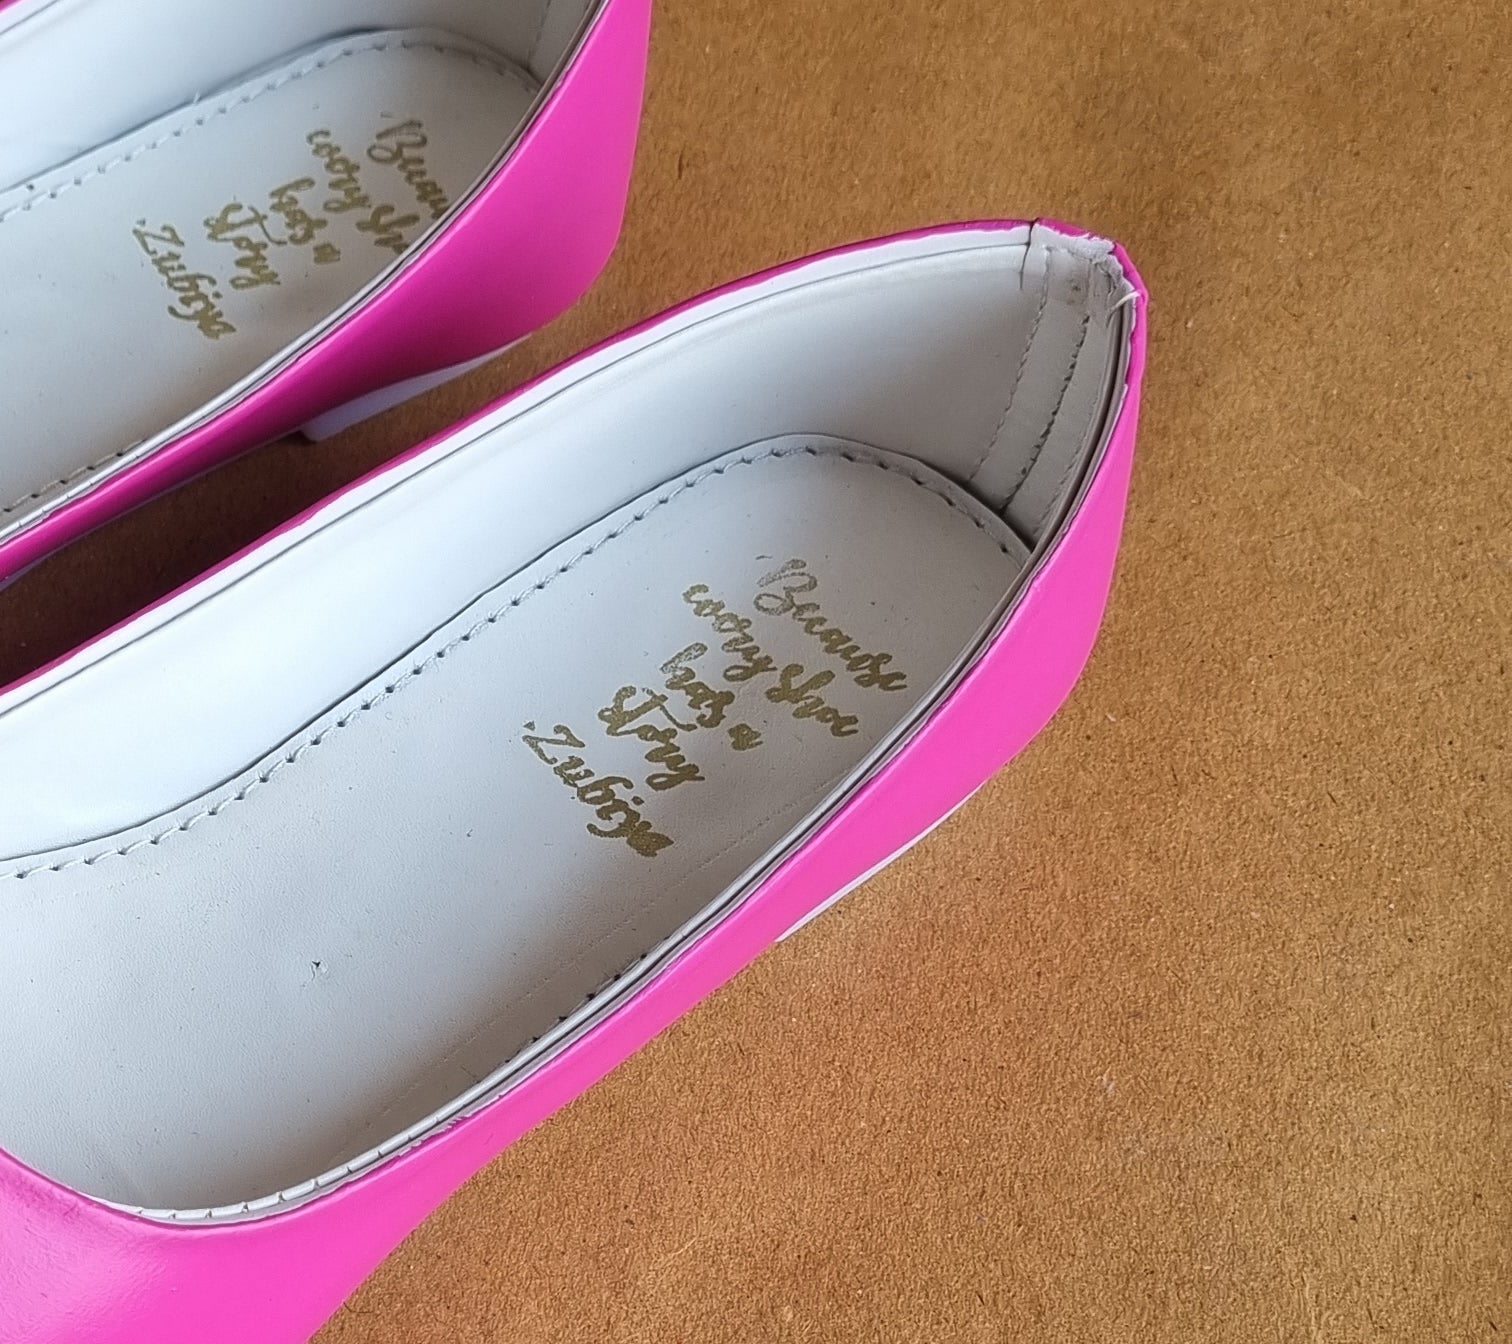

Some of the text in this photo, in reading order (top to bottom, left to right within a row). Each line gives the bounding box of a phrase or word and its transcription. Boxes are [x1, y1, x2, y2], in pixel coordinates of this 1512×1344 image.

[269, 177, 341, 265] has a
[753, 559, 908, 692] Because
[659, 642, 764, 752] has a
